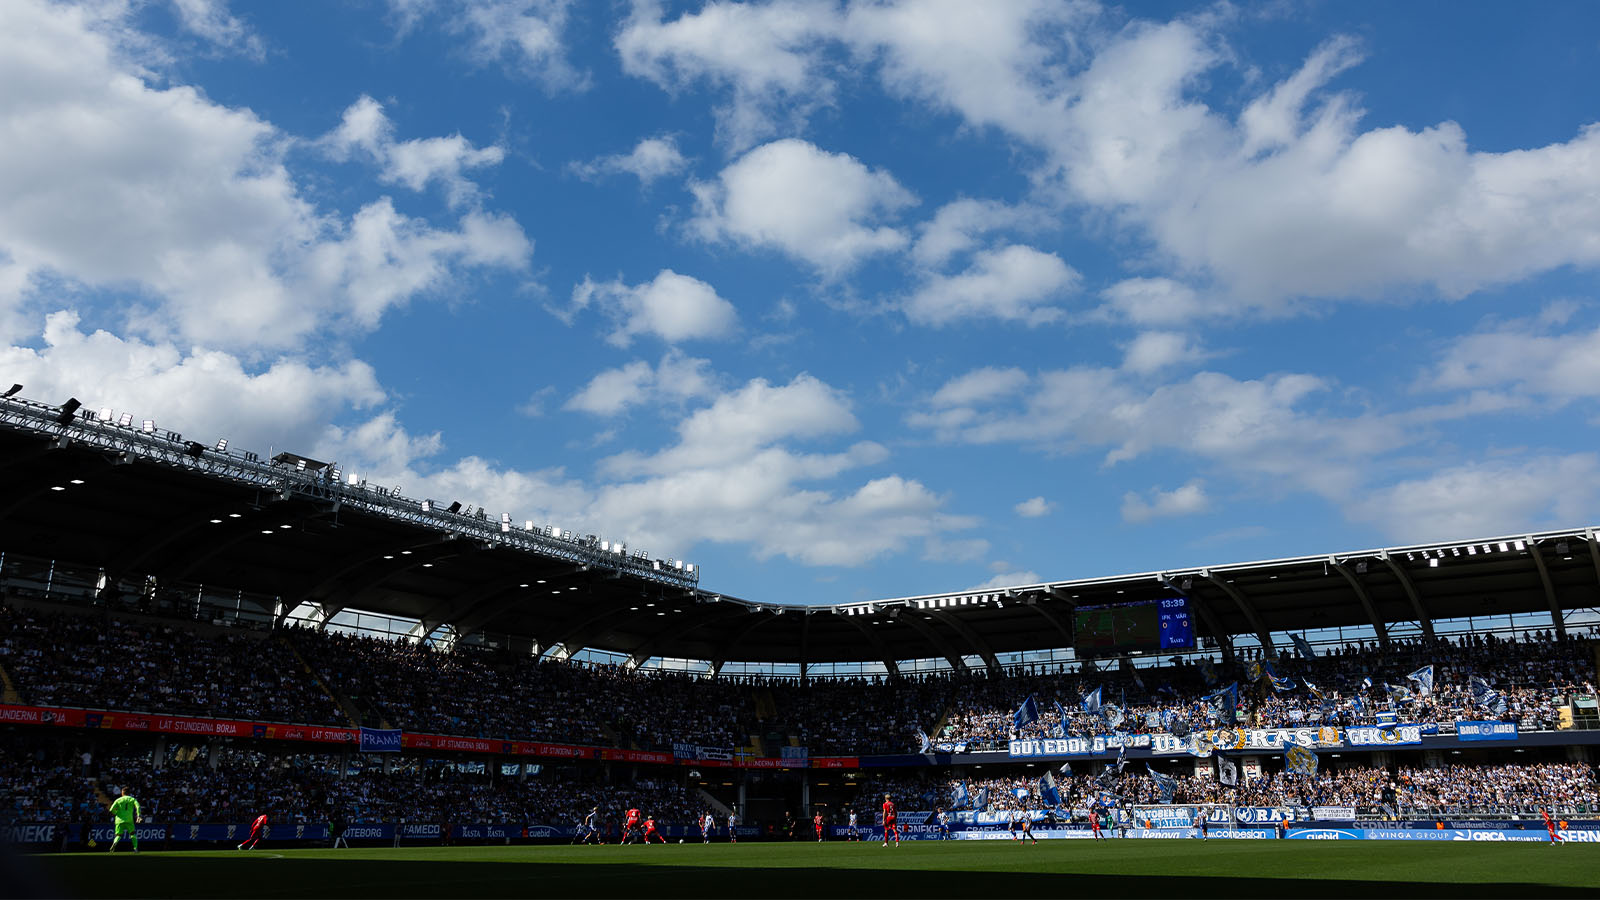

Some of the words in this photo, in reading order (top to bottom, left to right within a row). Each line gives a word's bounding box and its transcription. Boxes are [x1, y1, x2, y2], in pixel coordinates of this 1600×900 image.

[1161, 599, 1184, 608] 13:39
[41, 711, 66, 723] BRJA
[175, 721, 213, 732] STUNDERNA
[1459, 725, 1480, 735] BRIG
[1494, 724, 1515, 734] ADEN
[1348, 728, 1383, 745] GFK
[1401, 726, 1420, 742] 08
[404, 824, 440, 834] FAMECO
[1352, 821, 1413, 830] SERNEKE
[343, 826, 382, 838] ÖTEBORG
[463, 829, 481, 838] RASTA
[487, 829, 505, 838] RASTA
[529, 829, 551, 838] cuebid
[1141, 830, 1180, 839] Renova
[1473, 831, 1507, 841] ORCA
[1558, 830, 1600, 842] SERN
